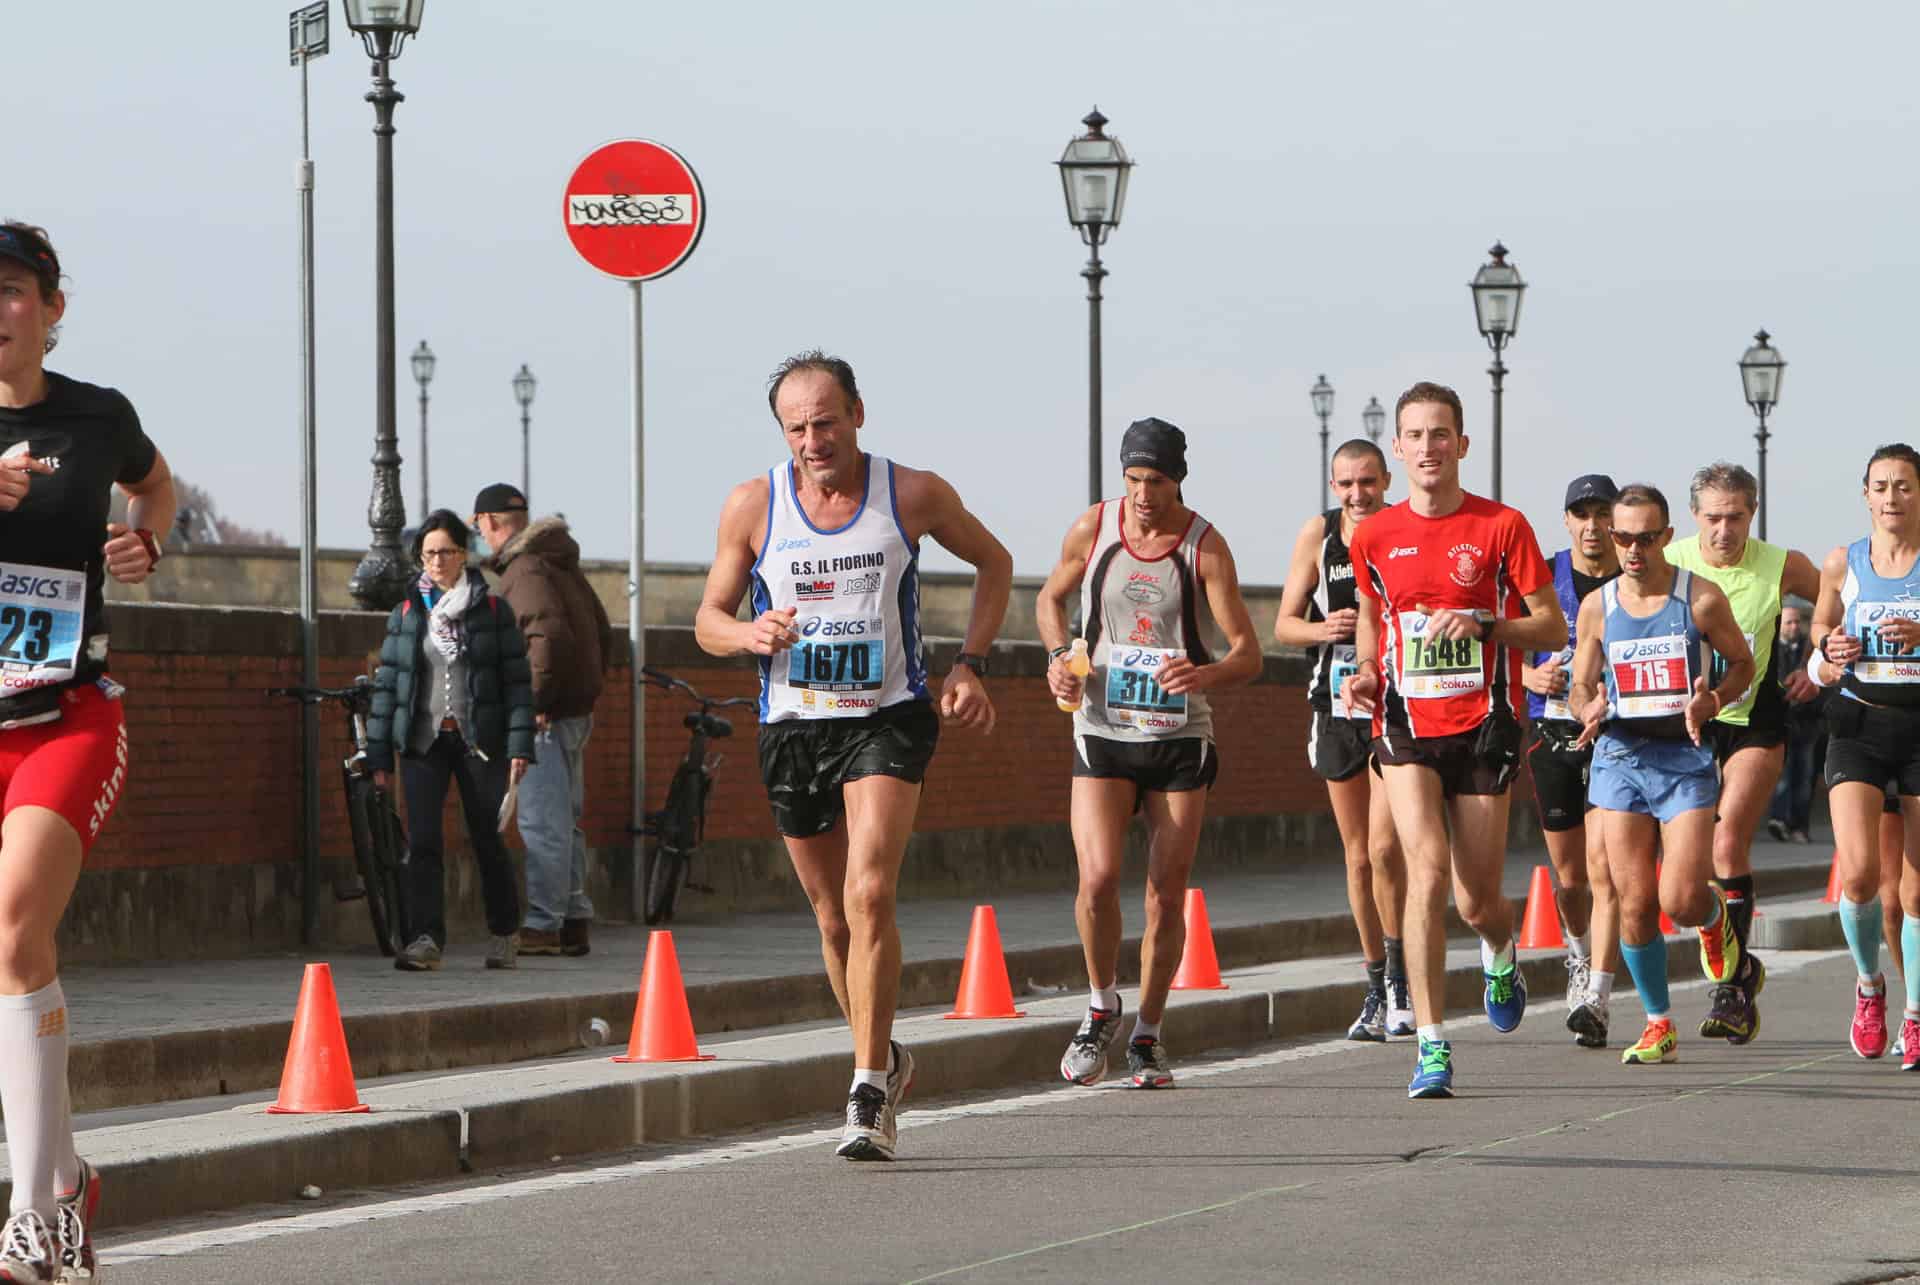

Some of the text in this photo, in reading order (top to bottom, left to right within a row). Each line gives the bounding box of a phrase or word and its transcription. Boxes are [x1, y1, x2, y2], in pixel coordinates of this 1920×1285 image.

[791, 552, 884, 575] G.S. IL FIORINO
[1, 574, 62, 598] asics
[0, 606, 52, 661] 23
[822, 620, 865, 636] asics
[1638, 643, 1671, 656] asics
[802, 642, 870, 681] 1670
[1442, 680, 1475, 689] CONAD
[1631, 660, 1671, 691] 715
[836, 698, 875, 708] CONAD
[1146, 719, 1178, 728] CONAD
